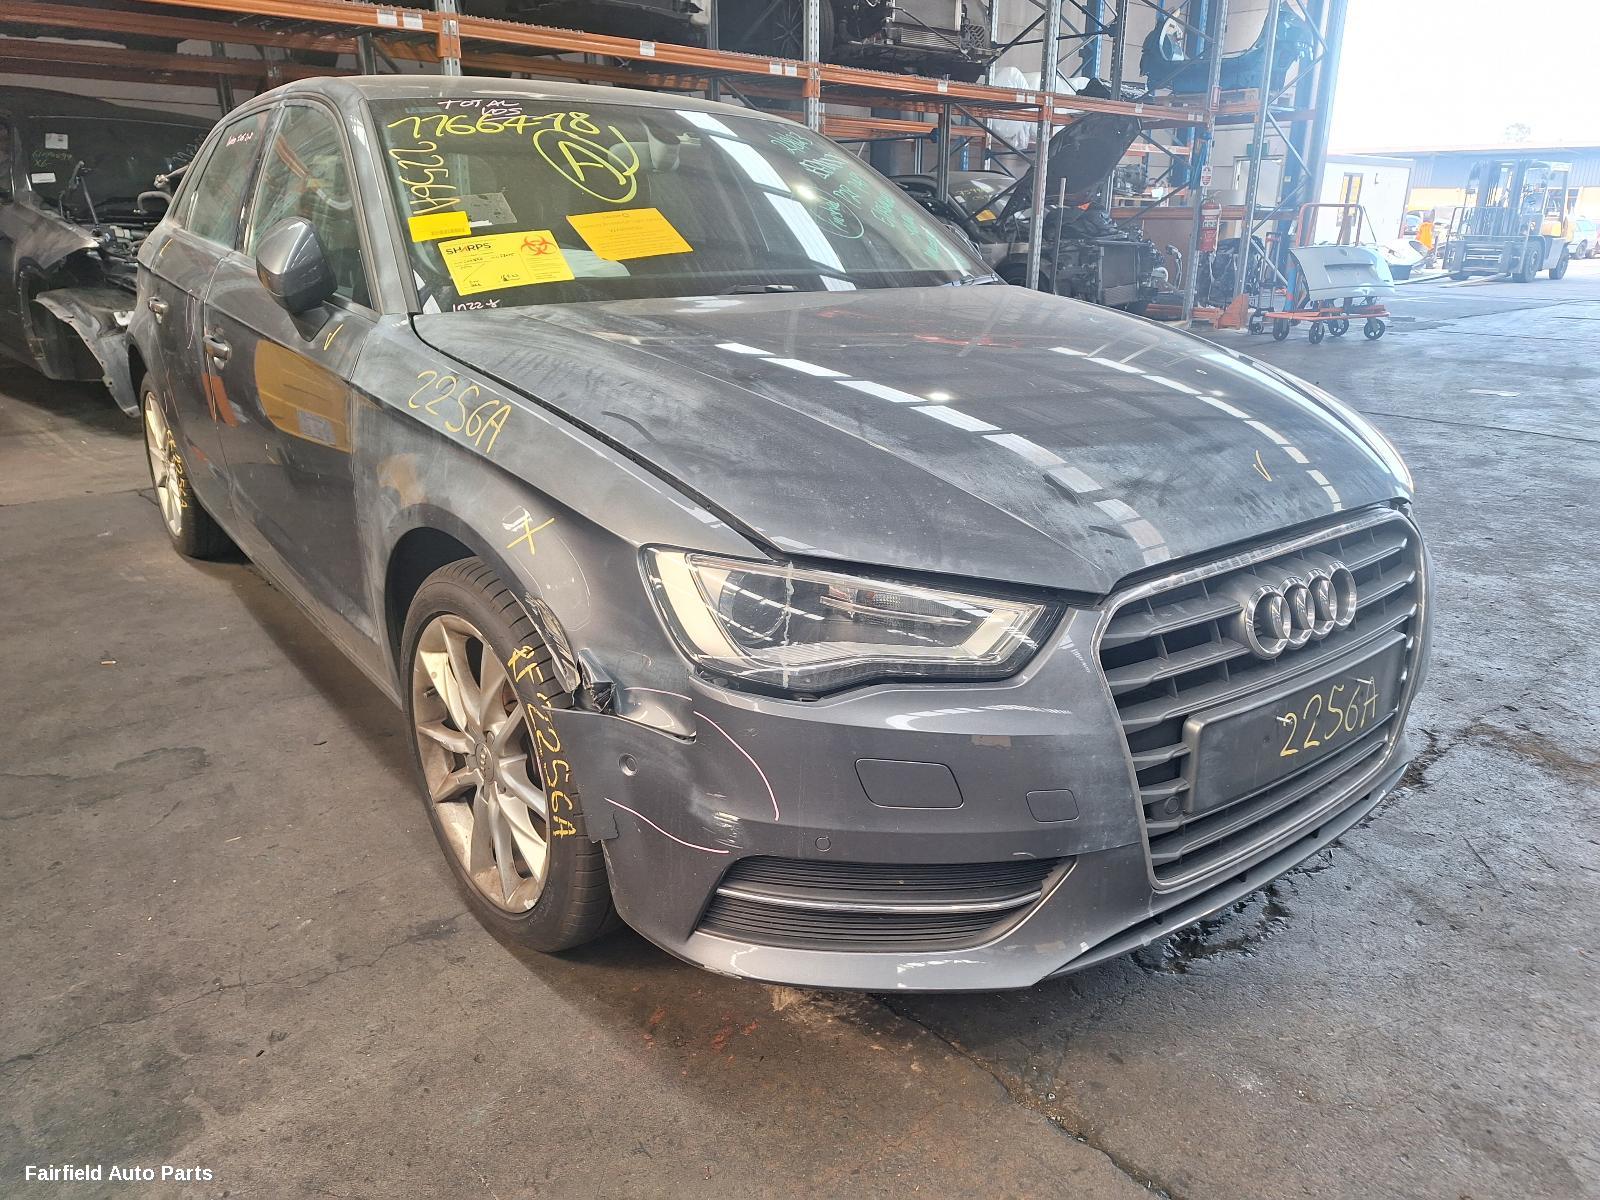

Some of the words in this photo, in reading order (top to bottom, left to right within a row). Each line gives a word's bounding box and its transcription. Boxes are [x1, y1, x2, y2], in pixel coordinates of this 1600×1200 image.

[388, 140, 461, 214] 2256A
[445, 242, 492, 255] SHARPS
[408, 370, 512, 453] 2256A
[1280, 676, 1379, 757] 2256A
[527, 692, 577, 839] 2256A
